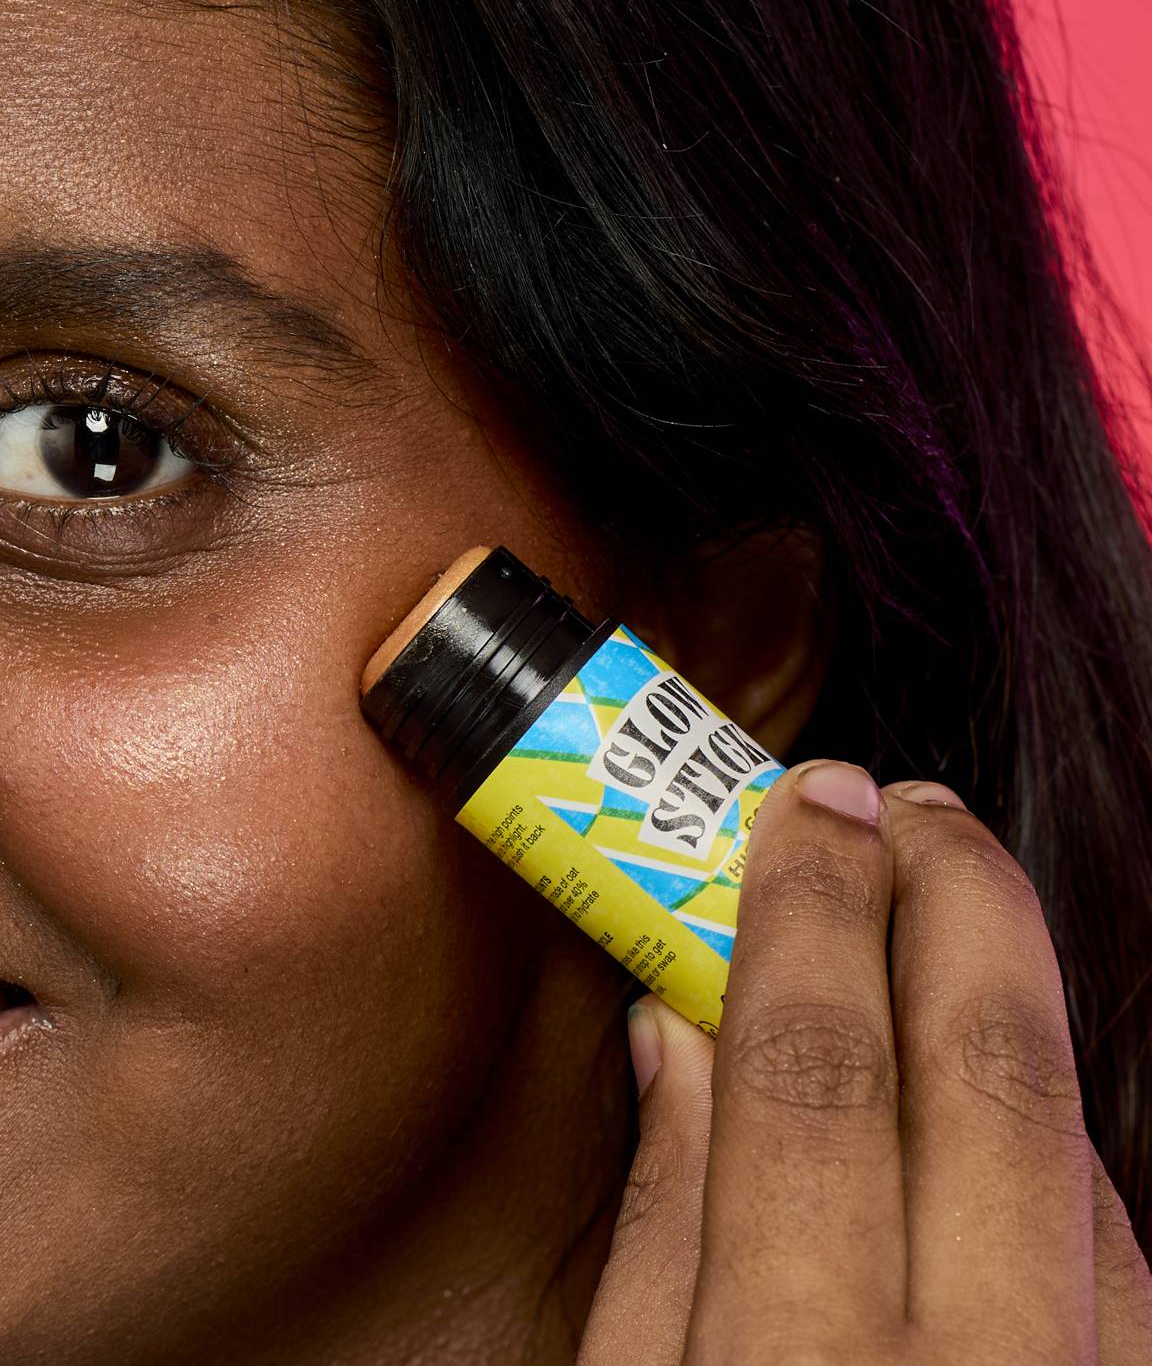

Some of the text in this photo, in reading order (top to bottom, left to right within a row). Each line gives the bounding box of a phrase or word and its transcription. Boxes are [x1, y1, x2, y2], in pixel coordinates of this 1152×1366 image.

[603, 676, 709, 788] GLOW
[651, 724, 773, 850] STICK
[500, 804, 523, 830] points
[500, 822, 528, 852] highlight.
[525, 823, 546, 845] back
[521, 841, 530, 850] it
[559, 876, 568, 889] of
[565, 866, 580, 882] oat
[570, 879, 588, 897] 40%
[575, 890, 599, 914] hydrate
[634, 934, 650, 949] this
[644, 951, 655, 959] to
[651, 938, 666, 956] get
[656, 950, 676, 971] swap
